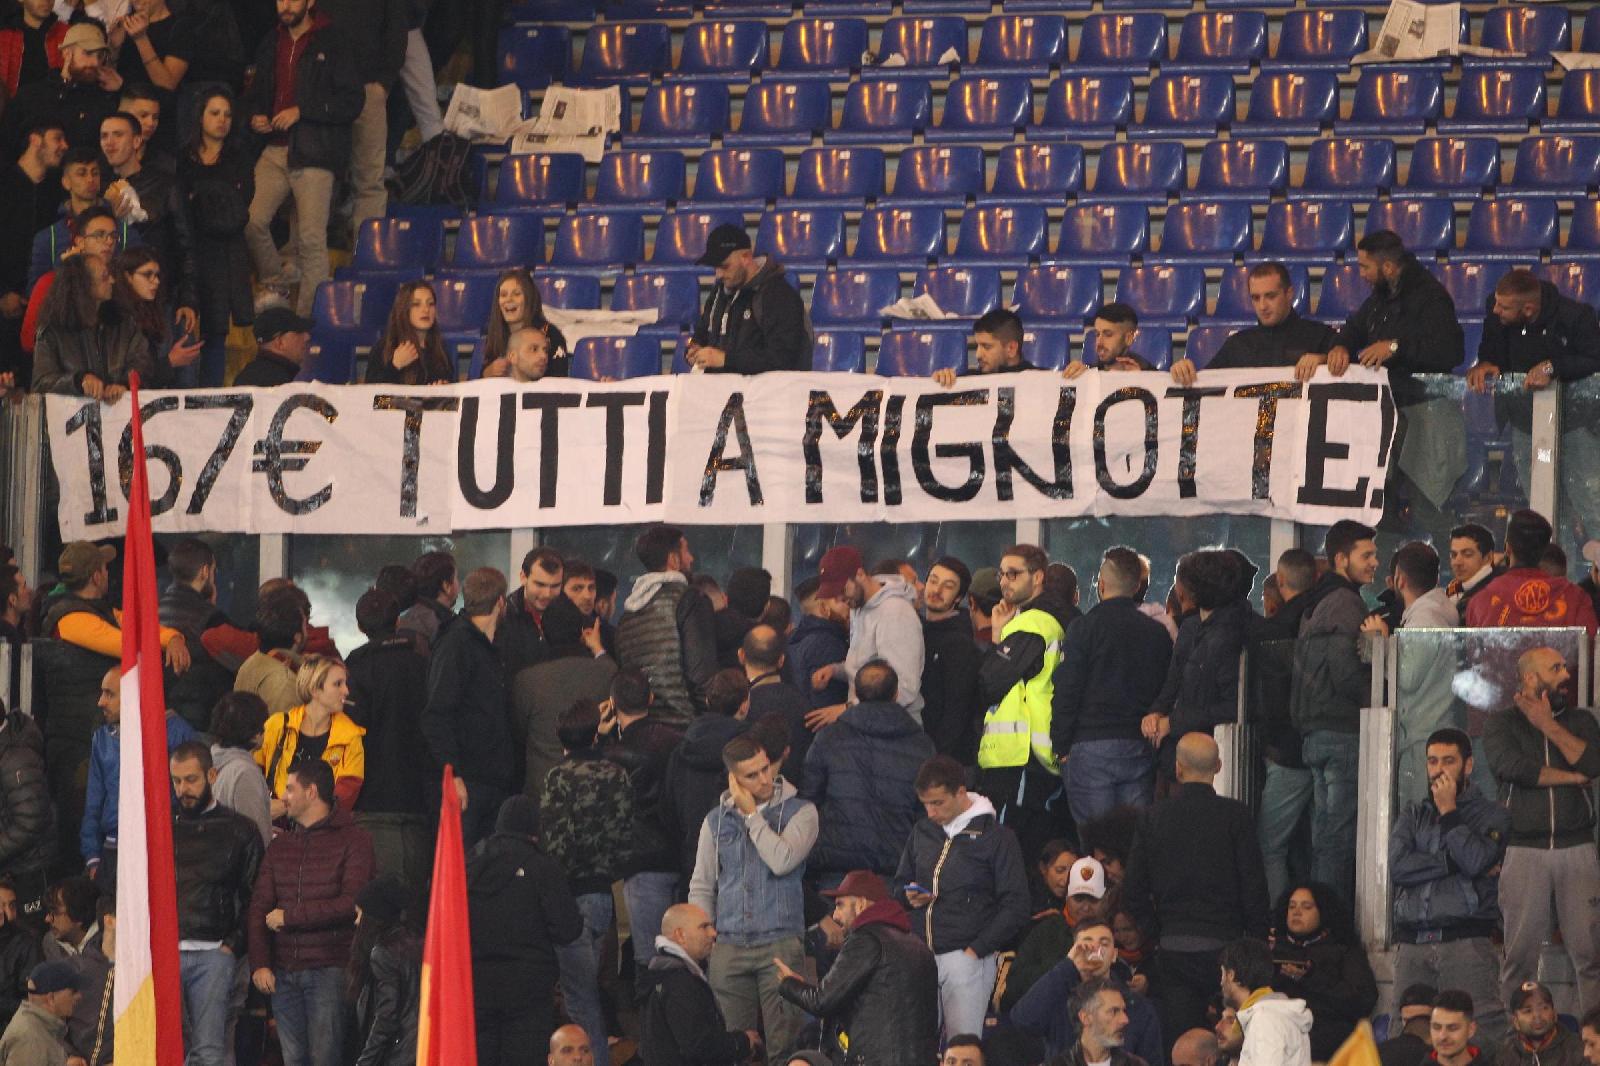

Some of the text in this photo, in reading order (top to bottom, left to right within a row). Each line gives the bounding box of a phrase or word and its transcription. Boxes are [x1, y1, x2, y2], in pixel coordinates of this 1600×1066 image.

[65, 383, 1395, 525] 167€ TUTTI A MIGNOTTE!
